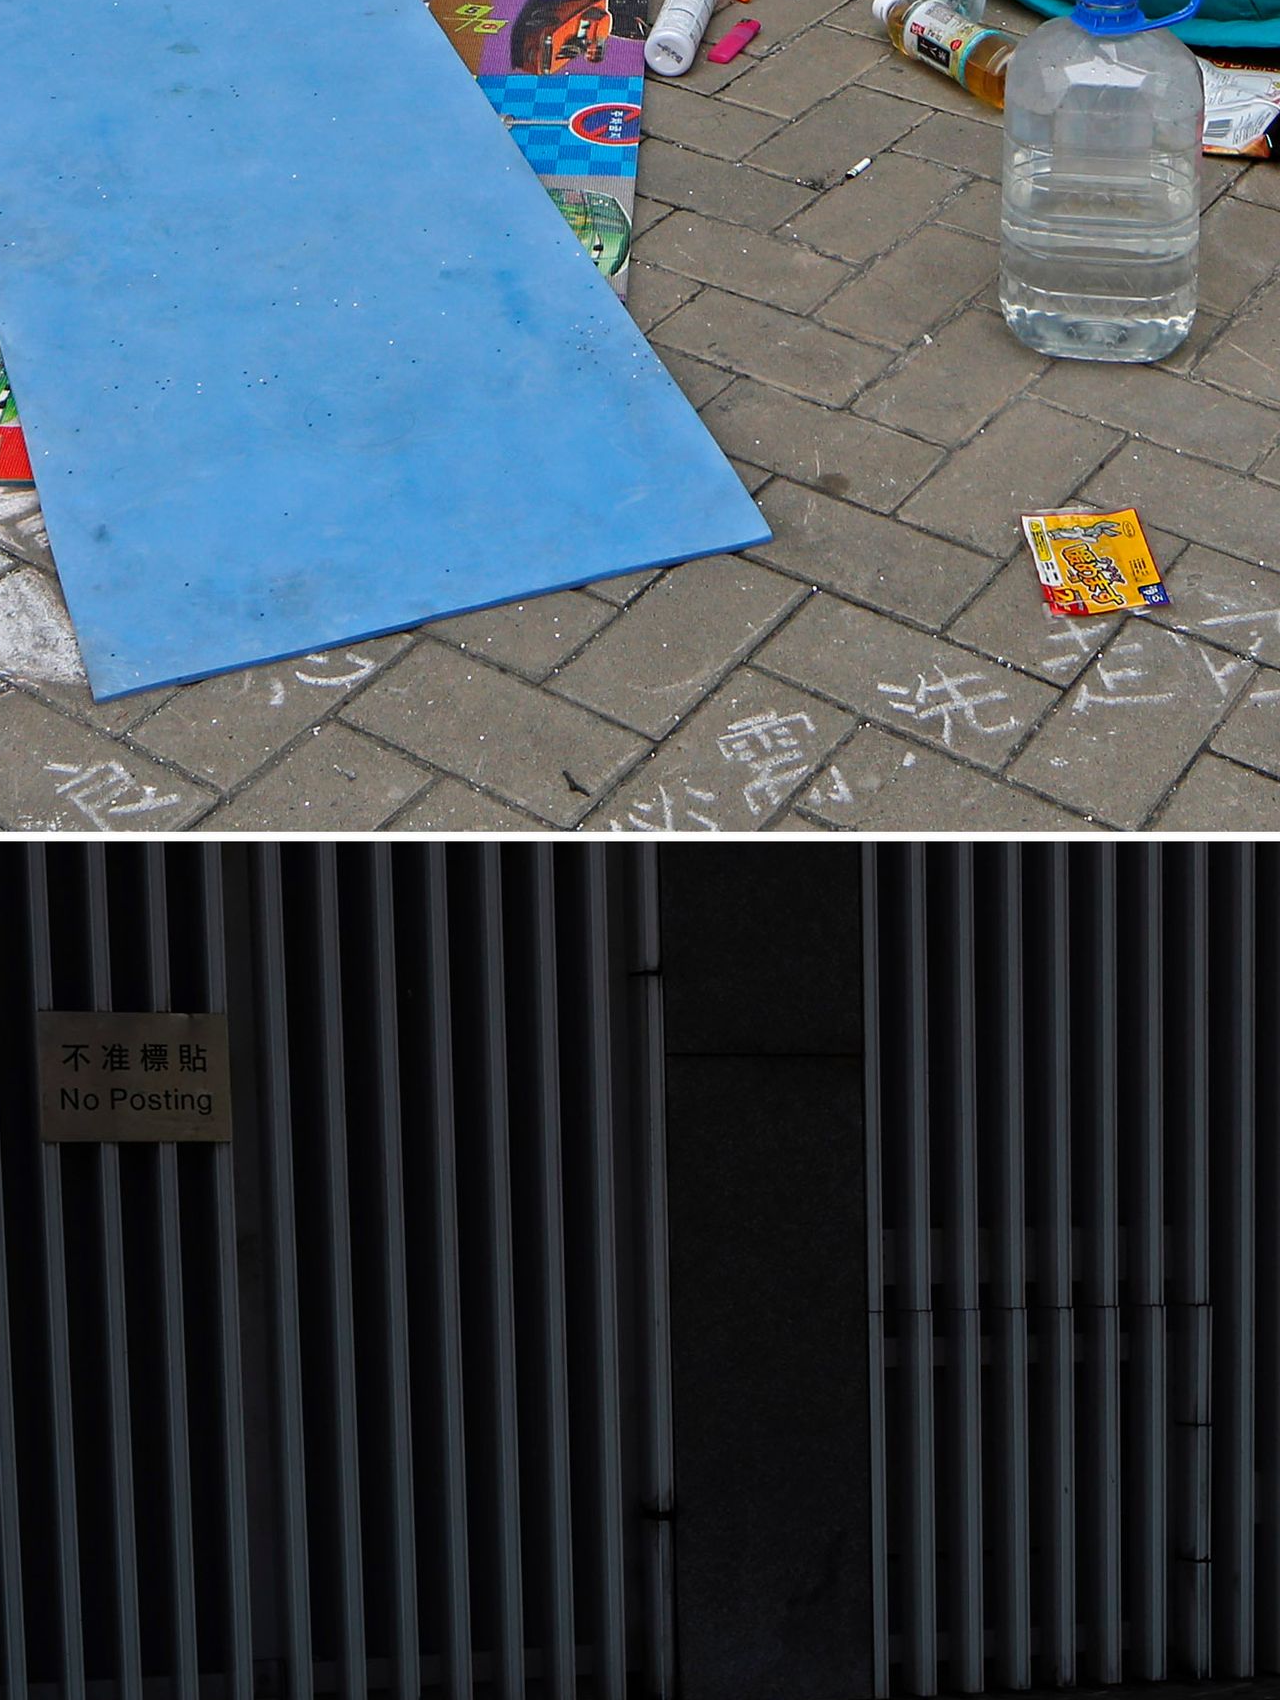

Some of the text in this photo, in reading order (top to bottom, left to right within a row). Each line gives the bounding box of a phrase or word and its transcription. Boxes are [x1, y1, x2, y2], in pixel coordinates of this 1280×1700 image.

[61, 1043, 208, 1072] 不准標貼
[60, 1088, 212, 1115] No Posting
